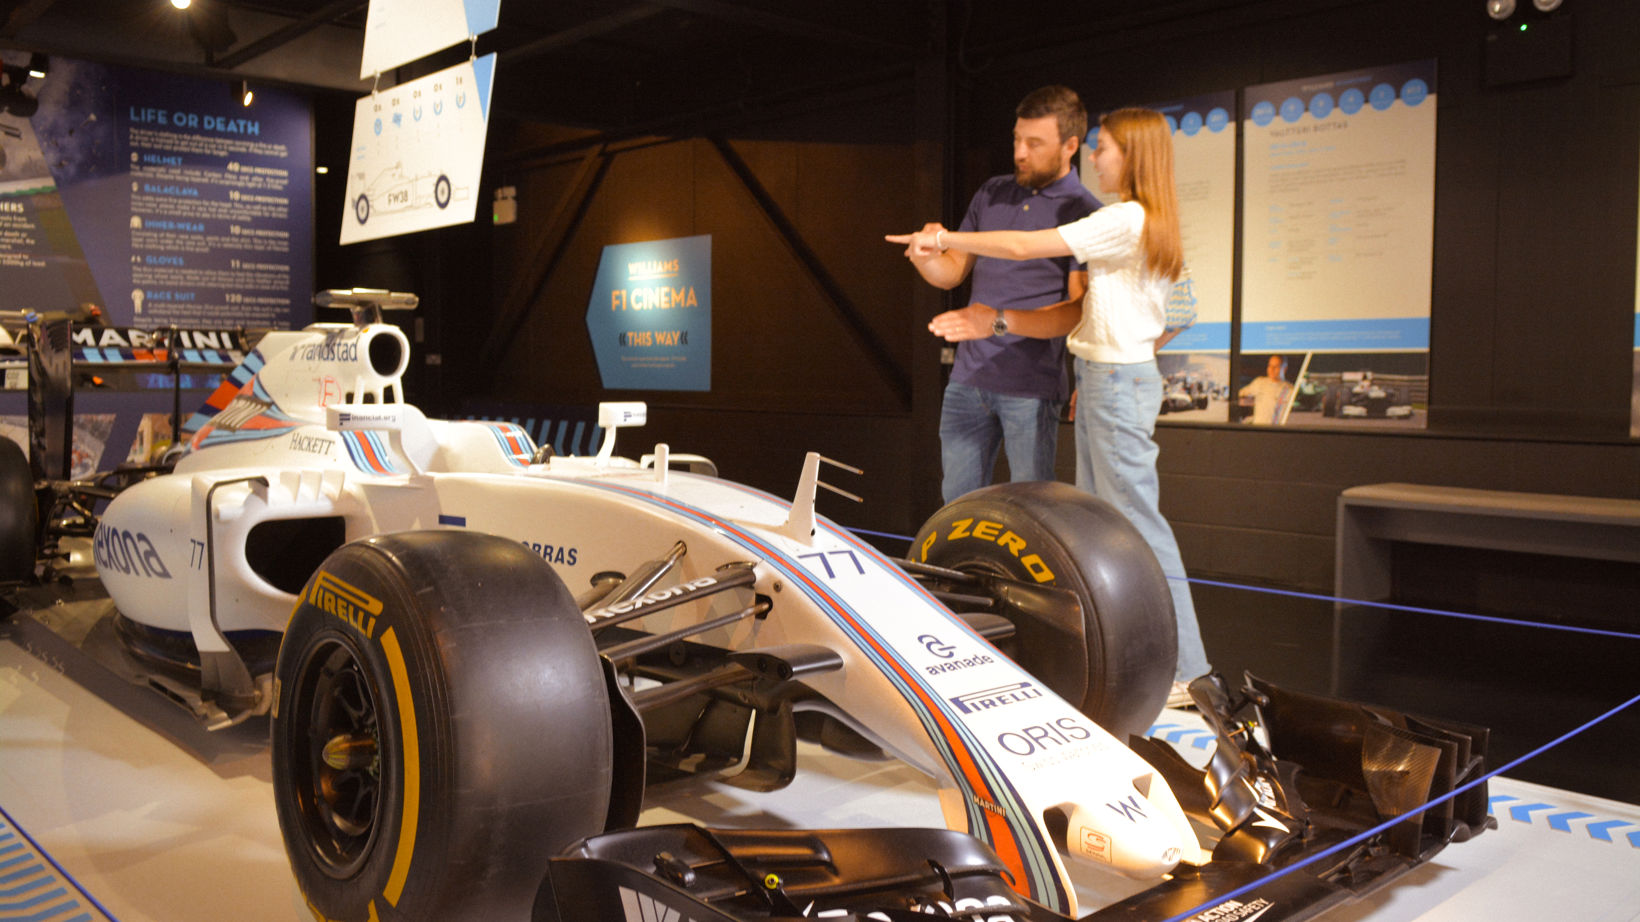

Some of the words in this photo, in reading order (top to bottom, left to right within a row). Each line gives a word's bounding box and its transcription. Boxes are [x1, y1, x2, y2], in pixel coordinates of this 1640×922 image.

[129, 106, 168, 125] LIFE
[173, 112, 199, 128] OR
[203, 115, 260, 136] DEATH
[143, 154, 183, 166] HELMET
[144, 184, 199, 197] BALACLAVA
[387, 190, 408, 206] FW38
[144, 220, 205, 233] INNER-WEAR
[145, 255, 184, 266] GLOVES
[628, 259, 680, 275] WILLIAMS
[146, 290, 171, 301] RACE
[174, 291, 195, 302] SUIT
[611, 289, 627, 311] F1
[630, 286, 698, 311] CINEMA
[73, 327, 233, 349] MARINI
[300, 334, 360, 361] randstad
[627, 331, 653, 347] THIS
[655, 330, 680, 346] WAY
[289, 432, 335, 455] HACKETT
[190, 538, 205, 570] 77
[921, 531, 937, 563] P
[947, 518, 1055, 583] ZERO
[797, 550, 865, 579] 77
[309, 570, 384, 640] PIRELLI
[583, 577, 717, 624] rexona
[925, 653, 994, 676] avanade
[949, 682, 1043, 714] PIRELLI
[997, 717, 1091, 756] ORIS
[973, 794, 1006, 818] MARTINI
